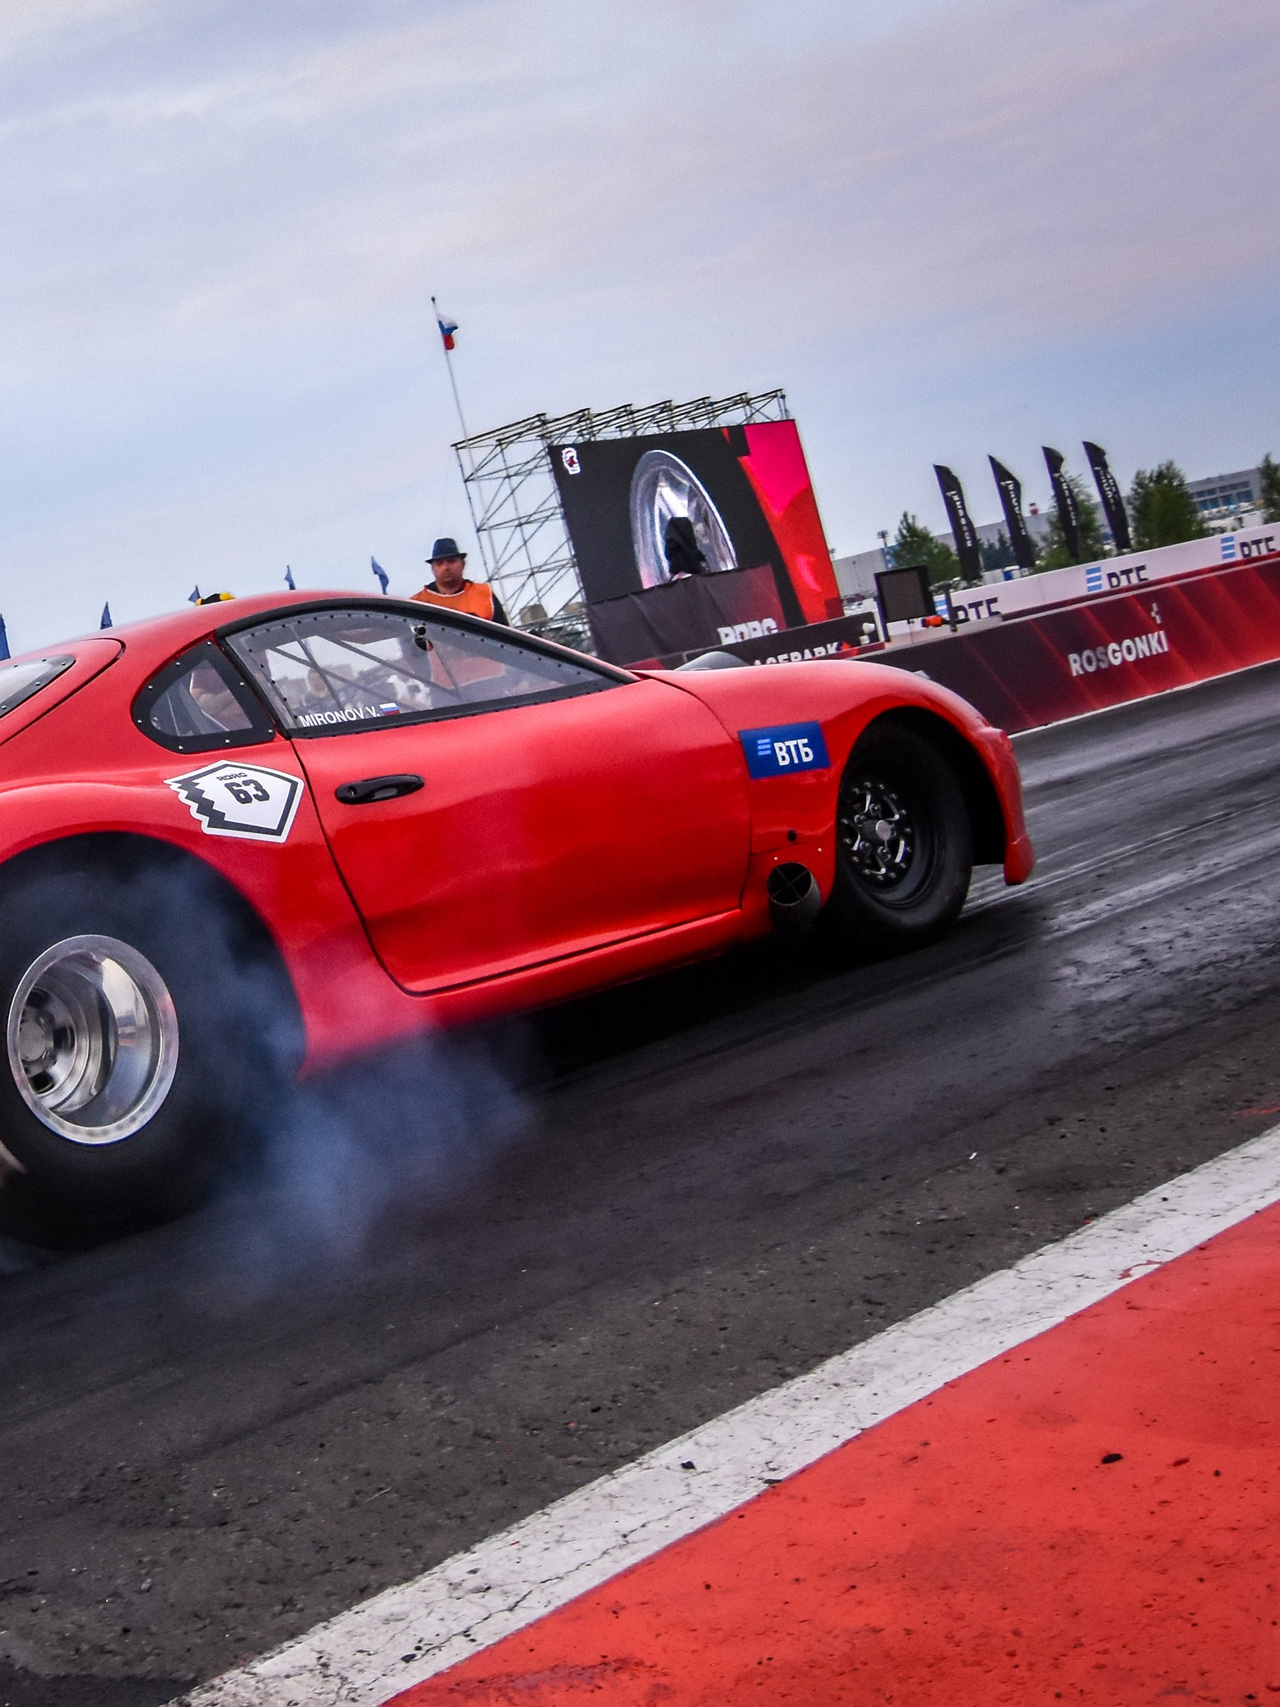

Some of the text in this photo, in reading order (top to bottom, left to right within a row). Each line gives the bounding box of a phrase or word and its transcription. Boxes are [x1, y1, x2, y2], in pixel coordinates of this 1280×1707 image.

[1067, 630, 1169, 677] ROSGONKI
[298, 706, 381, 727] MIRONOV V.
[773, 738, 814, 766] ВТБ
[224, 779, 270, 804] 63
